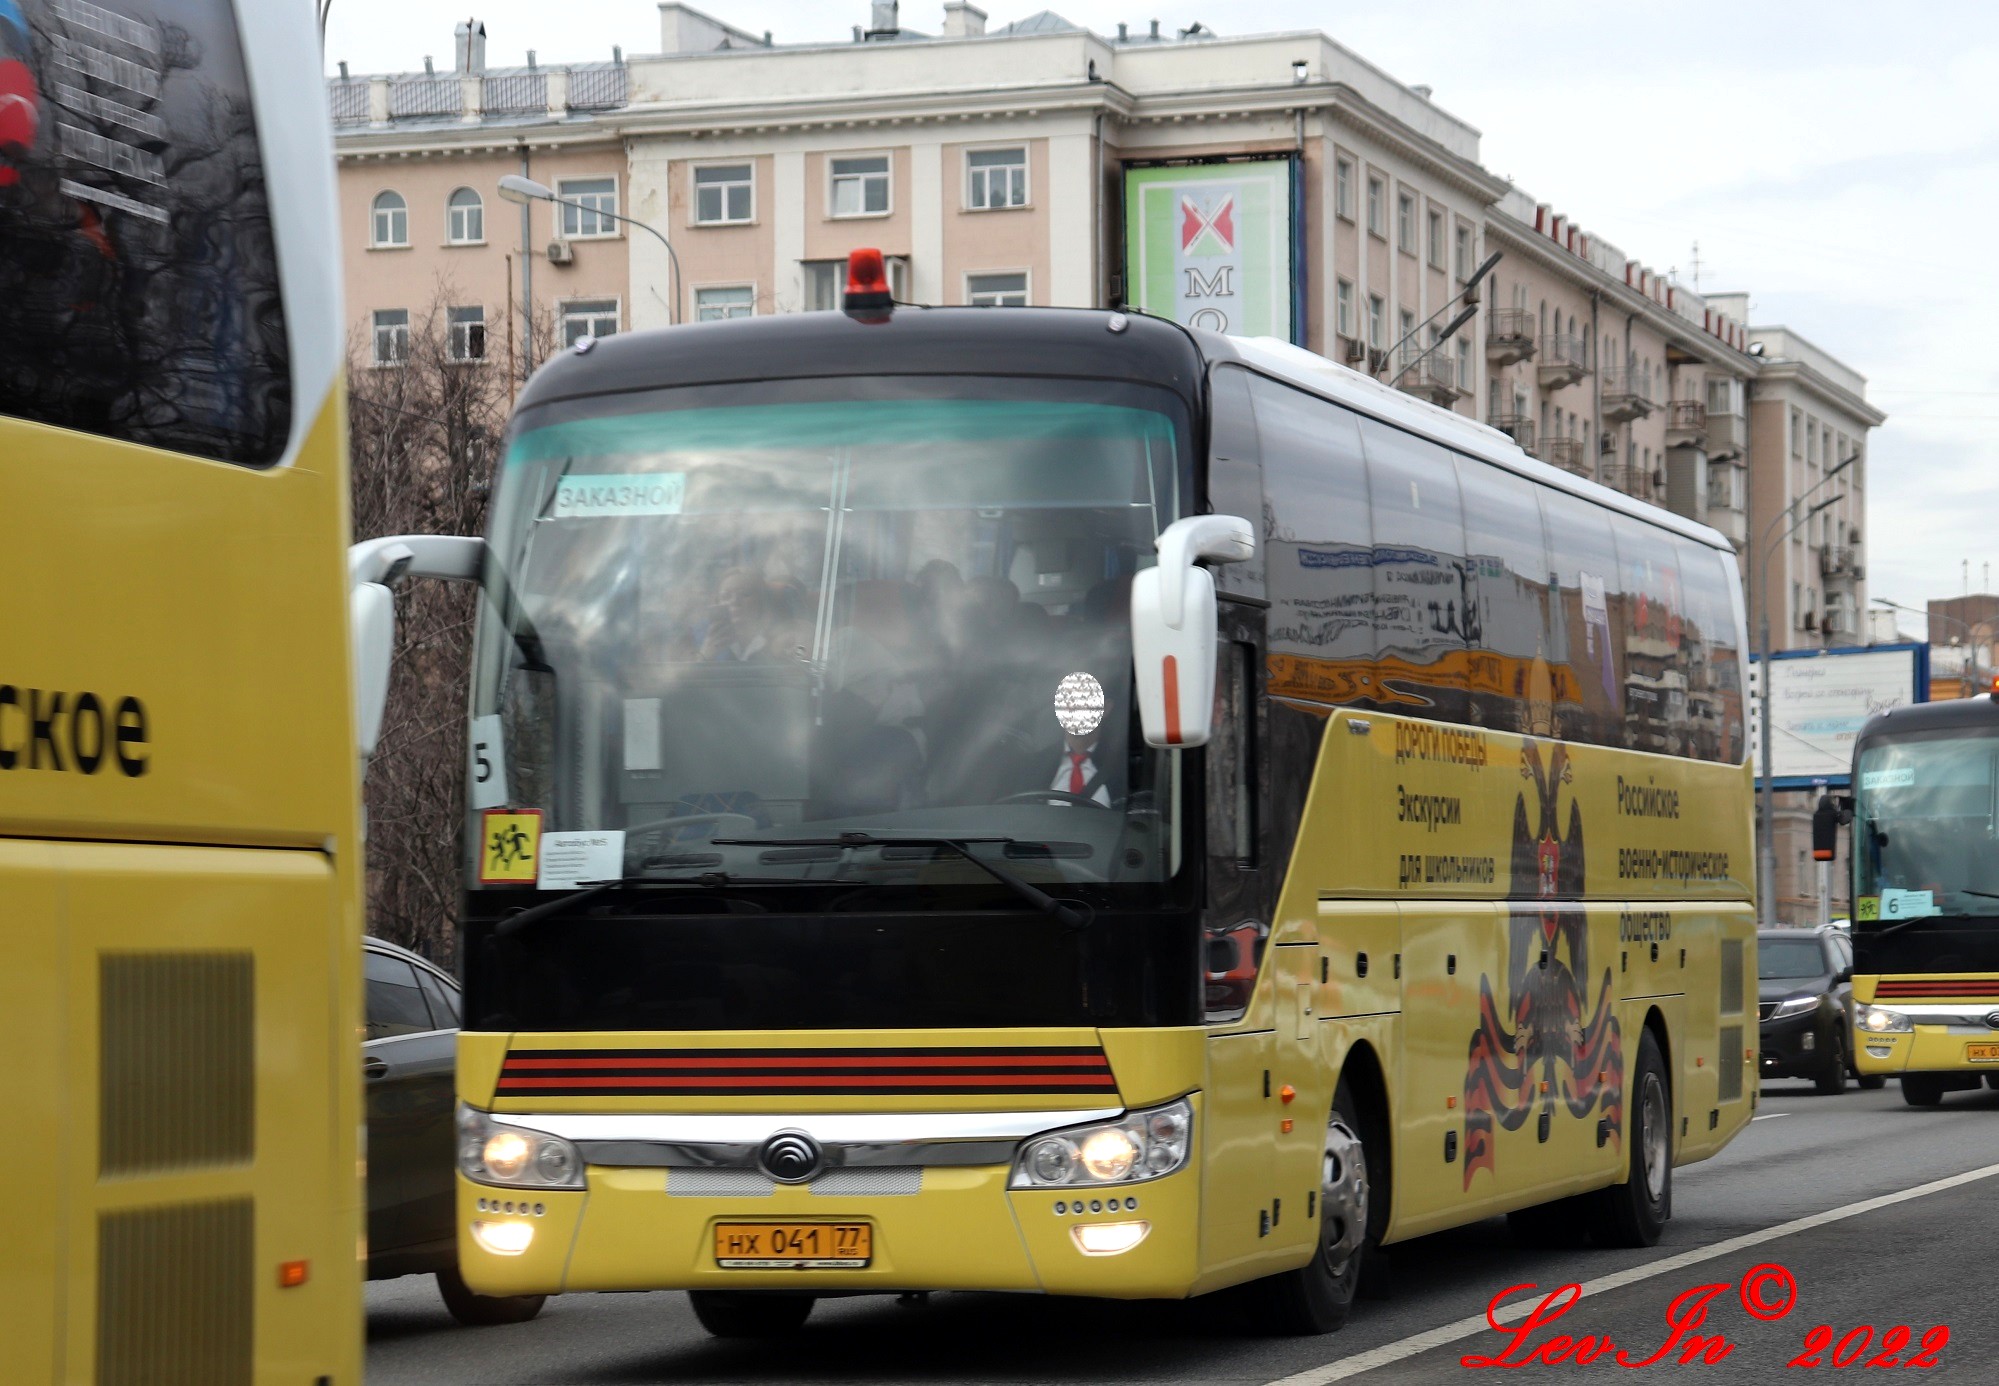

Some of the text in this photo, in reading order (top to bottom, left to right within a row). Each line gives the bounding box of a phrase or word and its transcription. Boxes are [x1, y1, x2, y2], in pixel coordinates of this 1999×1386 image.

[559, 481, 682, 509] ЗАКАЗНОЙ
[475, 742, 492, 783] 5
[1396, 721, 1488, 772] ДОРОГИ ПОБЕДЫ
[1864, 771, 1914, 785] ЗАКАЗНОЙ
[1397, 784, 1461, 832] Экскурсии
[1617, 775, 1680, 819] Российское
[1399, 855, 1495, 889] для школьников
[1619, 848, 1729, 889] военно-историческое
[1888, 898, 1899, 914] 6
[1620, 911, 1671, 948] общество
[770, 1228, 819, 1255] 041
[836, 1227, 862, 1248] 77
